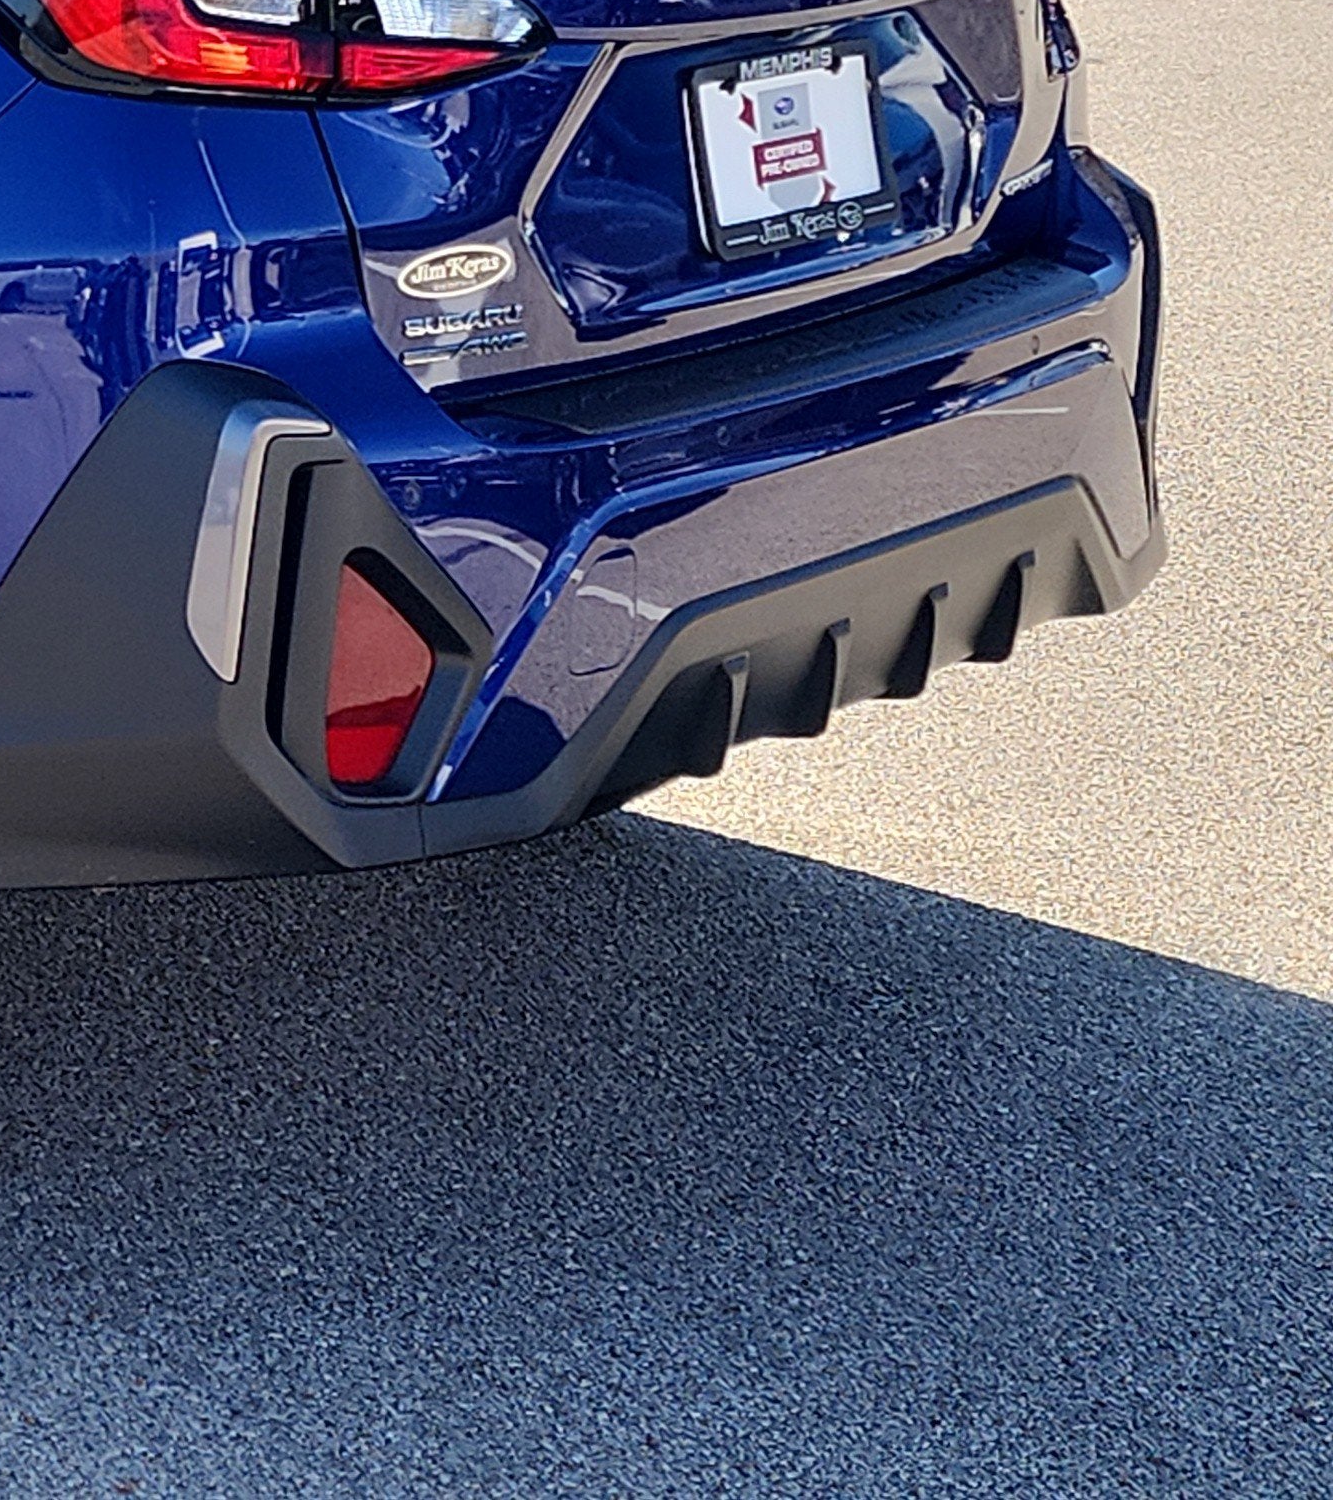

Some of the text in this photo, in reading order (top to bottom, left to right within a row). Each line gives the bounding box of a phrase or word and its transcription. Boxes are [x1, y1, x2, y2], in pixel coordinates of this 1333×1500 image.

[738, 47, 833, 82] MEMPHIS
[758, 210, 837, 246] Jim Keras
[410, 255, 501, 284] Jim Keras
[403, 304, 524, 338] SUBARU
